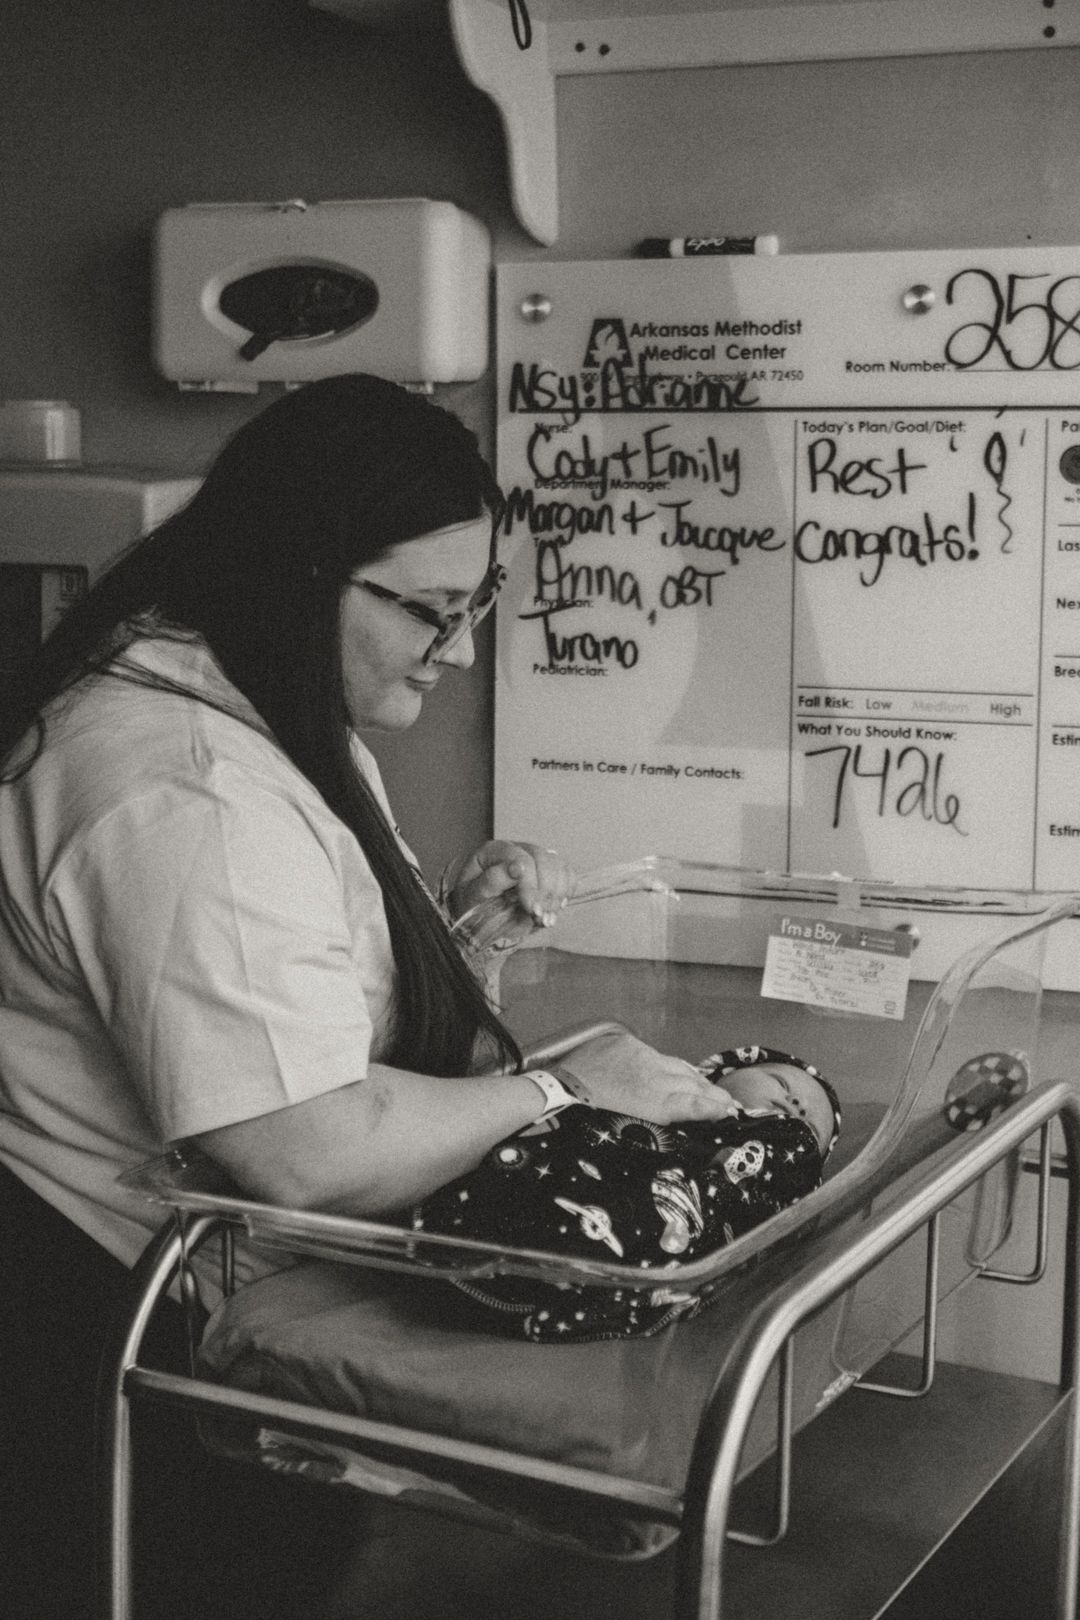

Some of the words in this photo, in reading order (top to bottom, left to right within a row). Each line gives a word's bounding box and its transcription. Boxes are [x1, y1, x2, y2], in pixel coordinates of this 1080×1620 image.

[630, 322, 709, 338] Arkansas
[714, 319, 802, 337] Methodist
[944, 268, 1080, 371] 258
[643, 344, 716, 361] Medical
[726, 344, 786, 360] Center
[751, 370, 767, 381] AR
[771, 369, 804, 382] 72450
[845, 361, 885, 373] Room
[890, 360, 951, 373] Number:
[802, 420, 854, 435] Today's
[858, 420, 967, 435] Plan/Goal/Diet:
[527, 429, 610, 501] Cody
[643, 424, 740, 497] Emily
[808, 438, 927, 499] Rest
[534, 479, 605, 491] Departmen
[610, 479, 670, 493] Manager:
[503, 486, 615, 546] Morgan
[534, 595, 594, 612] Phycan:
[533, 663, 608, 677] Pediatrician:
[798, 695, 821, 708] Fall
[824, 696, 854, 709] Risk:
[866, 698, 893, 710] Low
[990, 703, 1022, 719] High
[797, 723, 832, 736] What
[836, 724, 861, 737] You
[866, 726, 911, 739] Should
[916, 728, 957, 741] Know:
[532, 758, 580, 772] Partners
[583, 760, 594, 772] in
[597, 761, 628, 774] Care
[640, 763, 681, 778] Family
[684, 765, 745, 780] Contacts:
[804, 744, 969, 837] 7426
[781, 918, 802, 936] I'm
[803, 927, 812, 938] a
[814, 923, 842, 948] Boy
